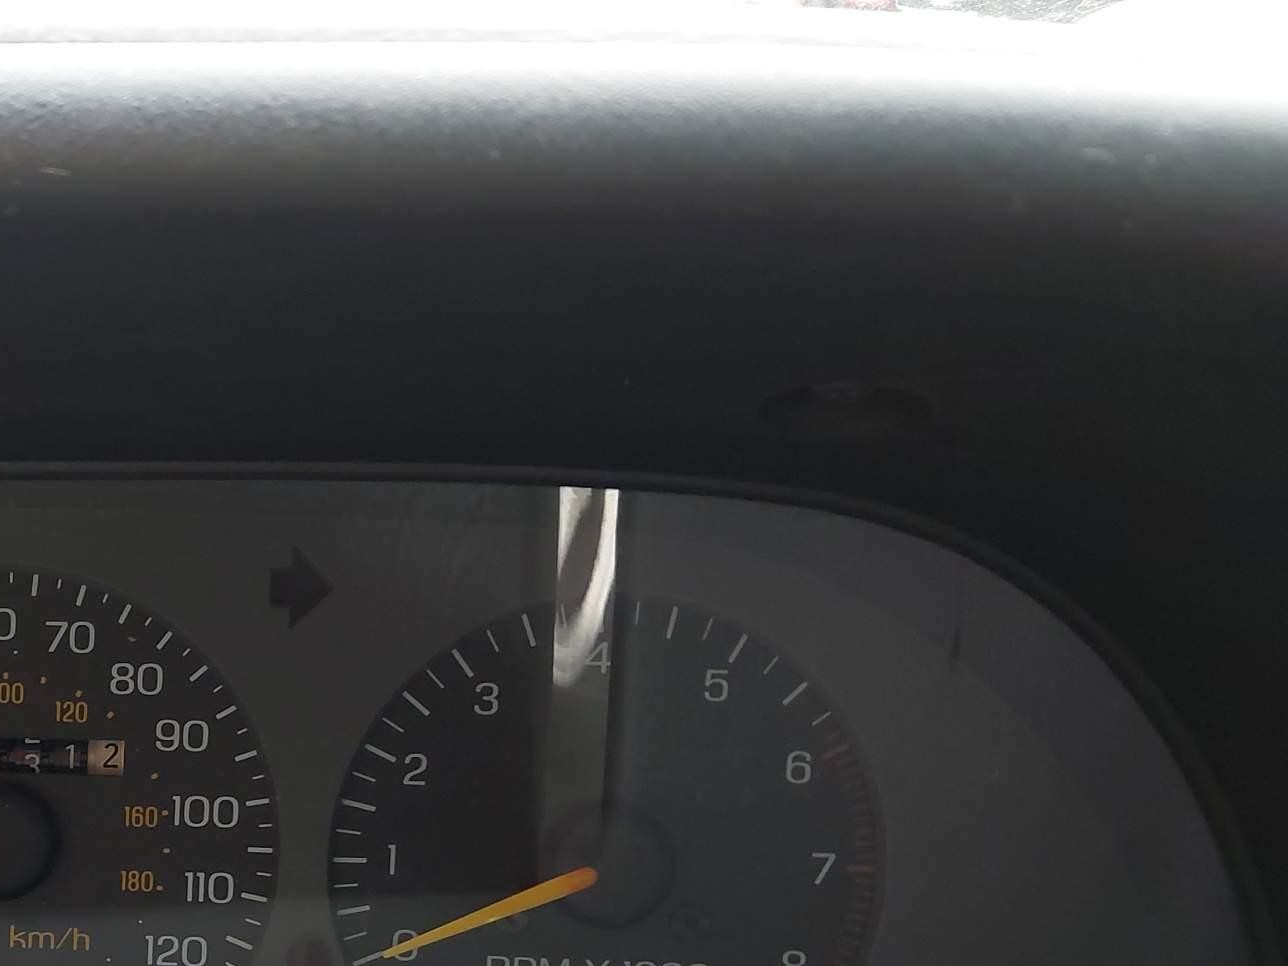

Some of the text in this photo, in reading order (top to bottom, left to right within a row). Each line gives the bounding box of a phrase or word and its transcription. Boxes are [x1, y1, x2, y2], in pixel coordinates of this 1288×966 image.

[46, 622, 94, 653] 70
[585, 642, 611, 674] 4
[111, 663, 162, 695] 80
[704, 670, 728, 701] 5
[56, 702, 87, 723] 120
[474, 683, 498, 715] 3
[156, 720, 208, 751] 90
[403, 754, 427, 785] 2
[786, 751, 811, 783] 6
[125, 807, 157, 827] 160
[173, 796, 238, 827] 100
[388, 845, 396, 875] 1
[812, 853, 836, 884] 7
[122, 871, 153, 891] 180
[185, 872, 233, 903] 110
[10, 925, 89, 950] km/h
[146, 936, 207, 966] 120
[392, 929, 418, 961] 0
